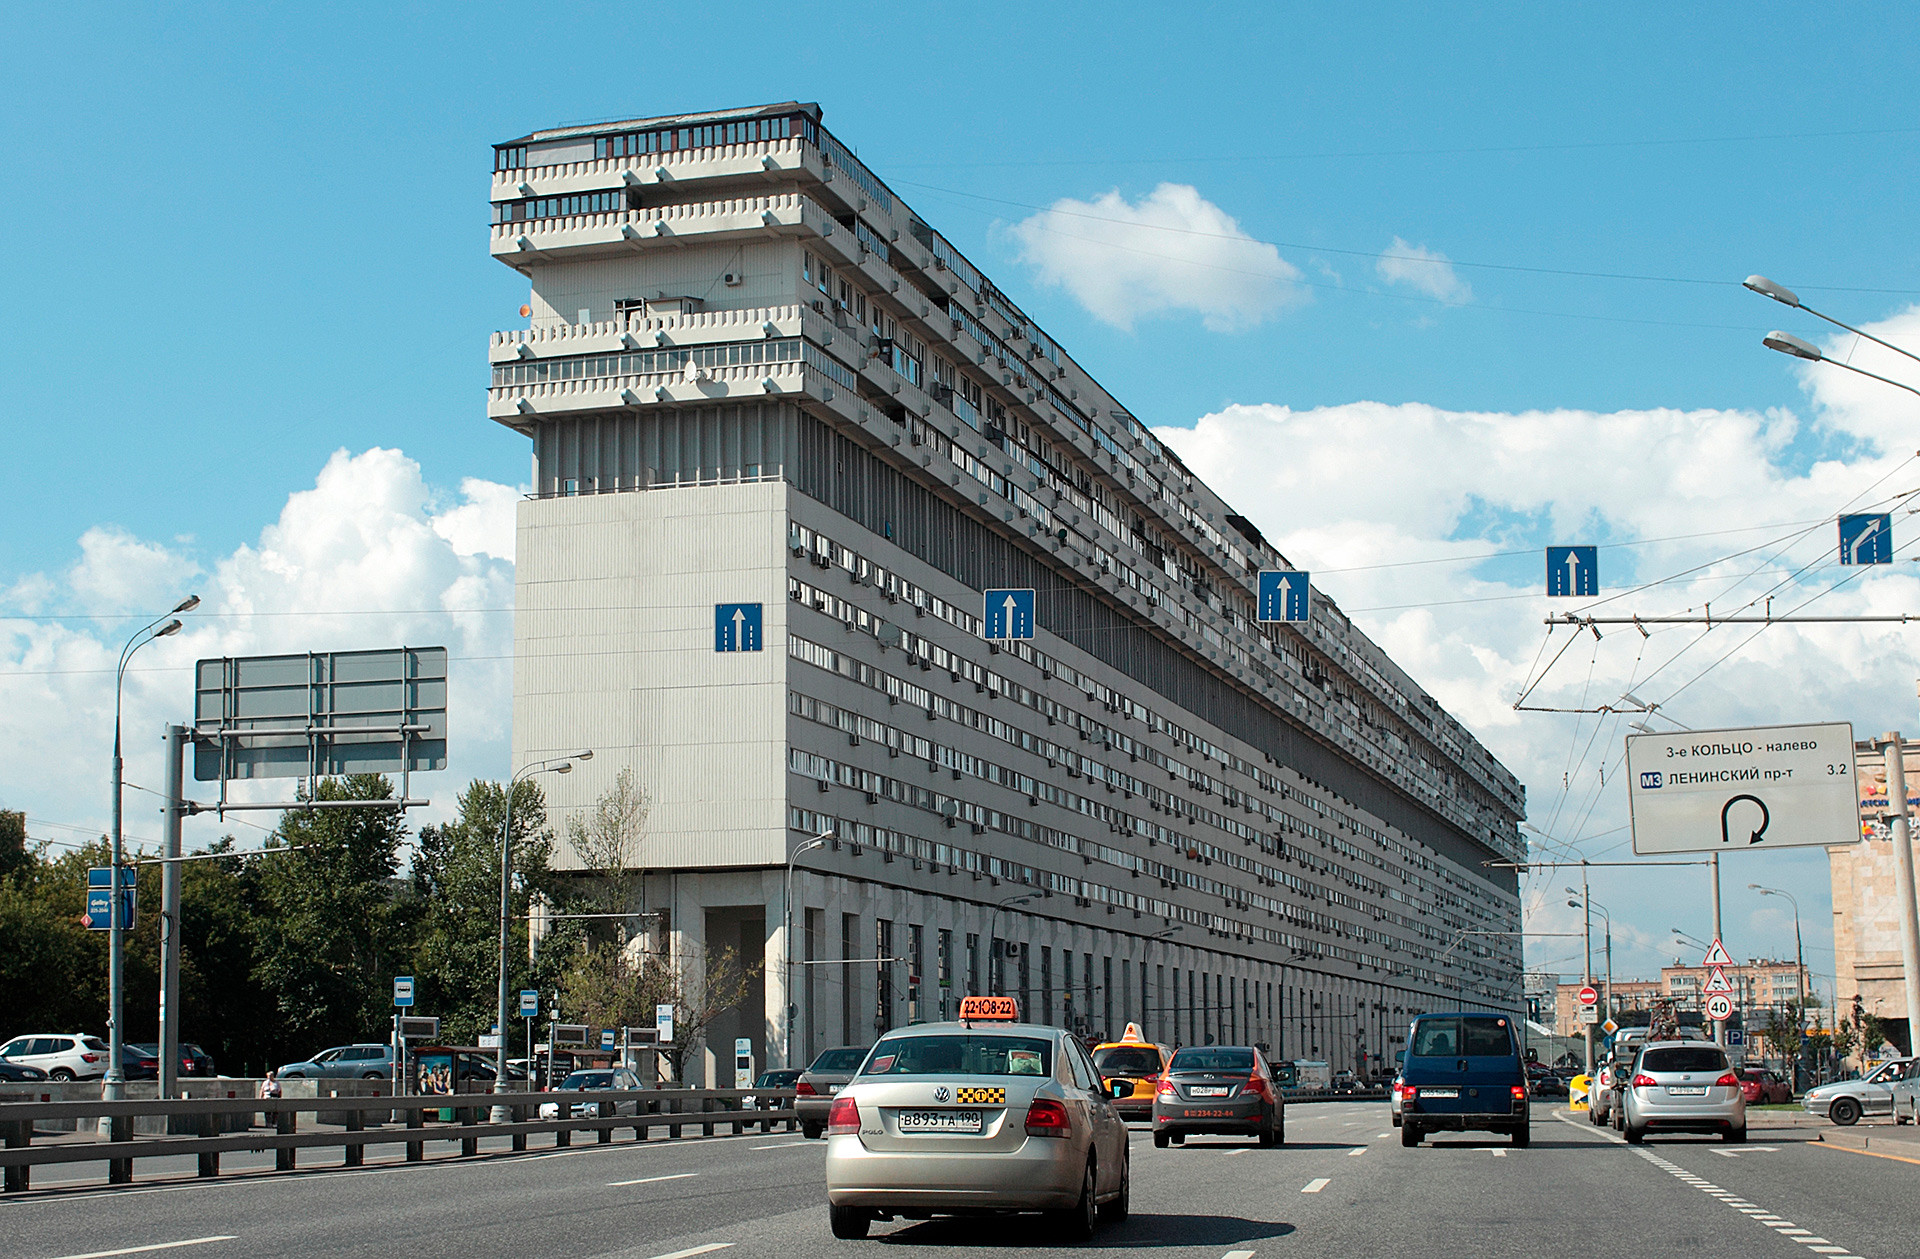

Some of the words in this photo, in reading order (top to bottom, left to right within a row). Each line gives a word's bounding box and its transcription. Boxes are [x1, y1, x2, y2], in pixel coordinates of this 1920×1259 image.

[1666, 746, 1687, 758] 3-е
[1692, 742, 1753, 757] КОЛЬЦО
[1766, 740, 1818, 752] налево
[1669, 766, 1760, 785] ЛЕНИНСКИЙ
[1764, 769, 1793, 782] пр-т
[1827, 763, 1847, 775] 3.2
[1711, 1001, 1727, 1013] 40
[1731, 1031, 1741, 1044] P
[904, 1112, 956, 1127] В893ТА
